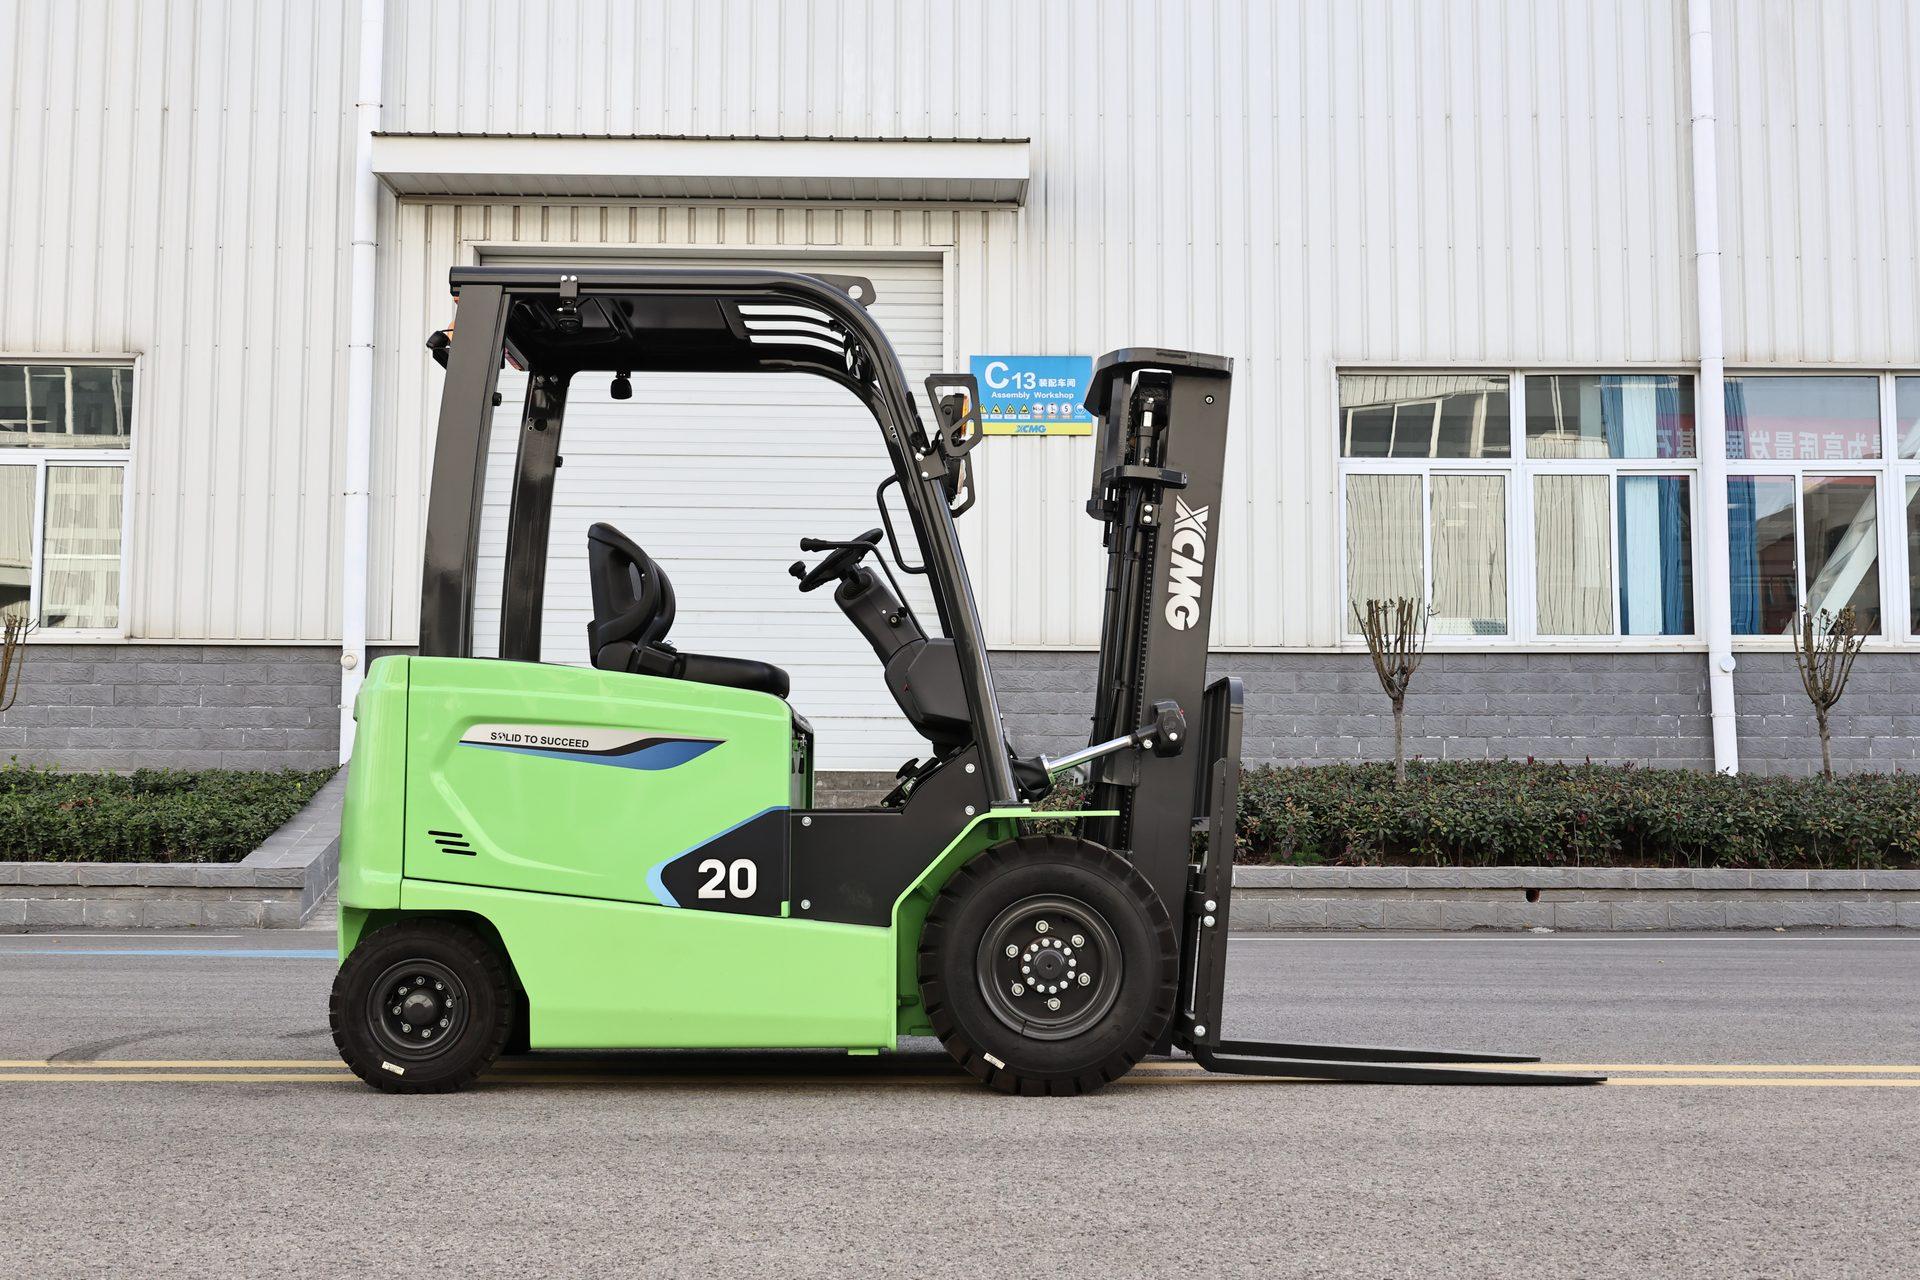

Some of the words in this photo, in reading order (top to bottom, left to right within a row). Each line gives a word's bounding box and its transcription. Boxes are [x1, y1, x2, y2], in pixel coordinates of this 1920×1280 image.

[991, 391, 1030, 400] Assembly
[1034, 391, 1075, 400] Workshop
[1015, 425, 1047, 434] XCMG
[1164, 494, 1210, 631] XCMG
[490, 732, 521, 742] SOLID
[524, 735, 538, 743] TO
[540, 736, 589, 748] SUCCEED
[698, 858, 757, 899] 20
